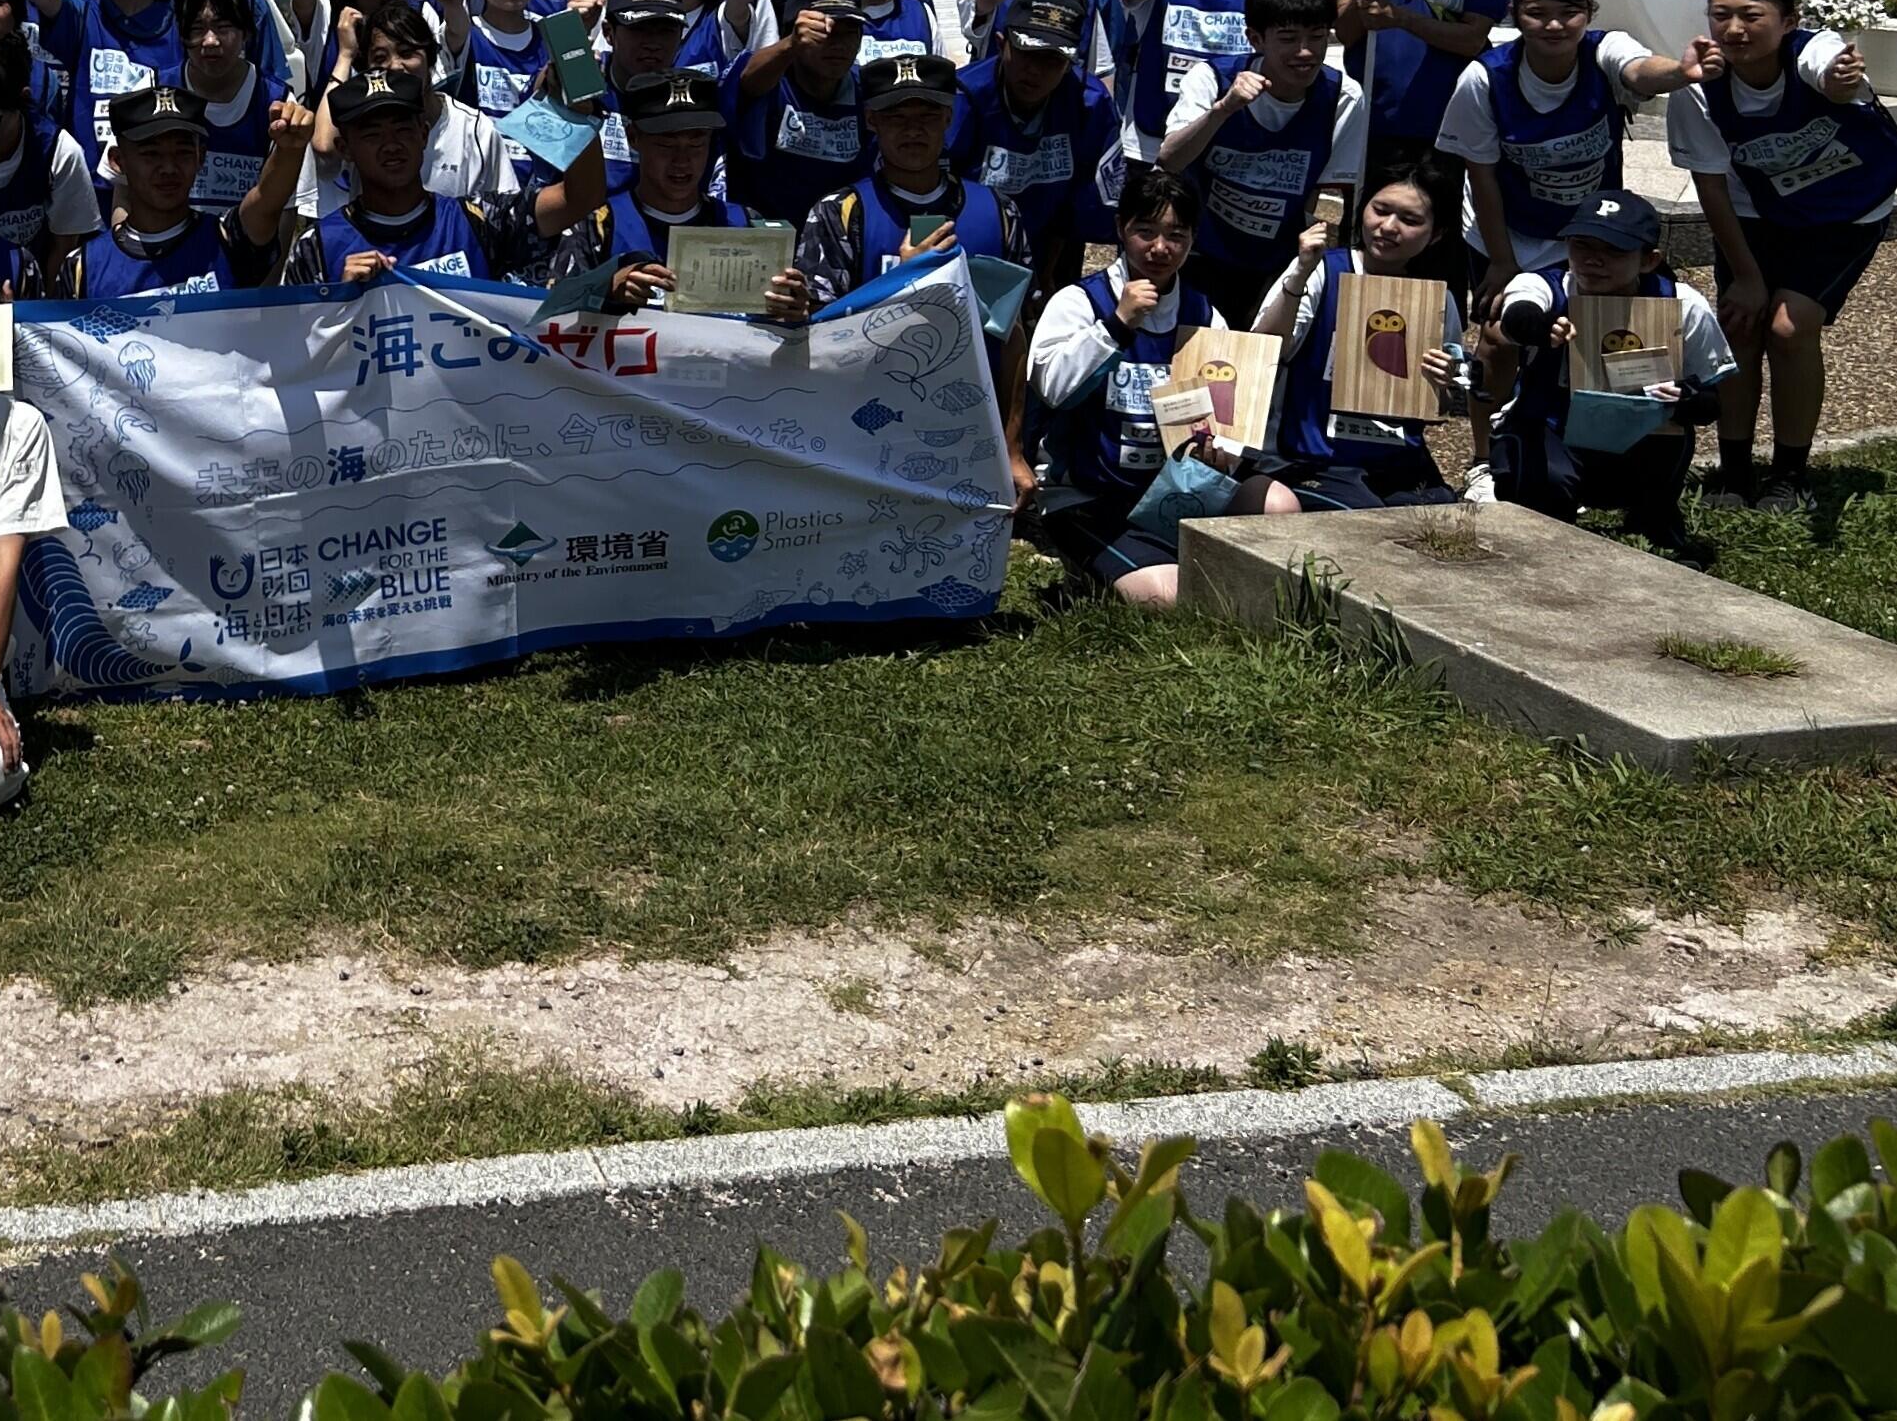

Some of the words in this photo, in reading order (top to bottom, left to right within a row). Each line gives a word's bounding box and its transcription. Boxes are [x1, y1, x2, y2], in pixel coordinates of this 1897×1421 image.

[1204, 15, 1246, 27] CHANG
[1226, 34, 1250, 46] BLU
[835, 140, 860, 152] BLU
[1596, 199, 1621, 217] P
[351, 313, 657, 385] 海ごみゼロ
[766, 510, 844, 532] Plastics
[317, 517, 448, 562] CHANGE
[566, 530, 670, 563] 環境省
[762, 530, 823, 552] Smart
[260, 544, 311, 574] 日本
[378, 552, 413, 571] FOR
[419, 547, 449, 564] THE
[261, 568, 311, 600] 財団
[379, 566, 451, 600] BLUE
[487, 571, 539, 588] Ministry
[544, 568, 559, 580] of
[561, 566, 582, 578] the
[585, 560, 669, 578] Environment
[213, 601, 312, 645] 海と日本
[321, 594, 453, 628] 海の未来を変える挑戦
[253, 621, 312, 640] PROJECT
